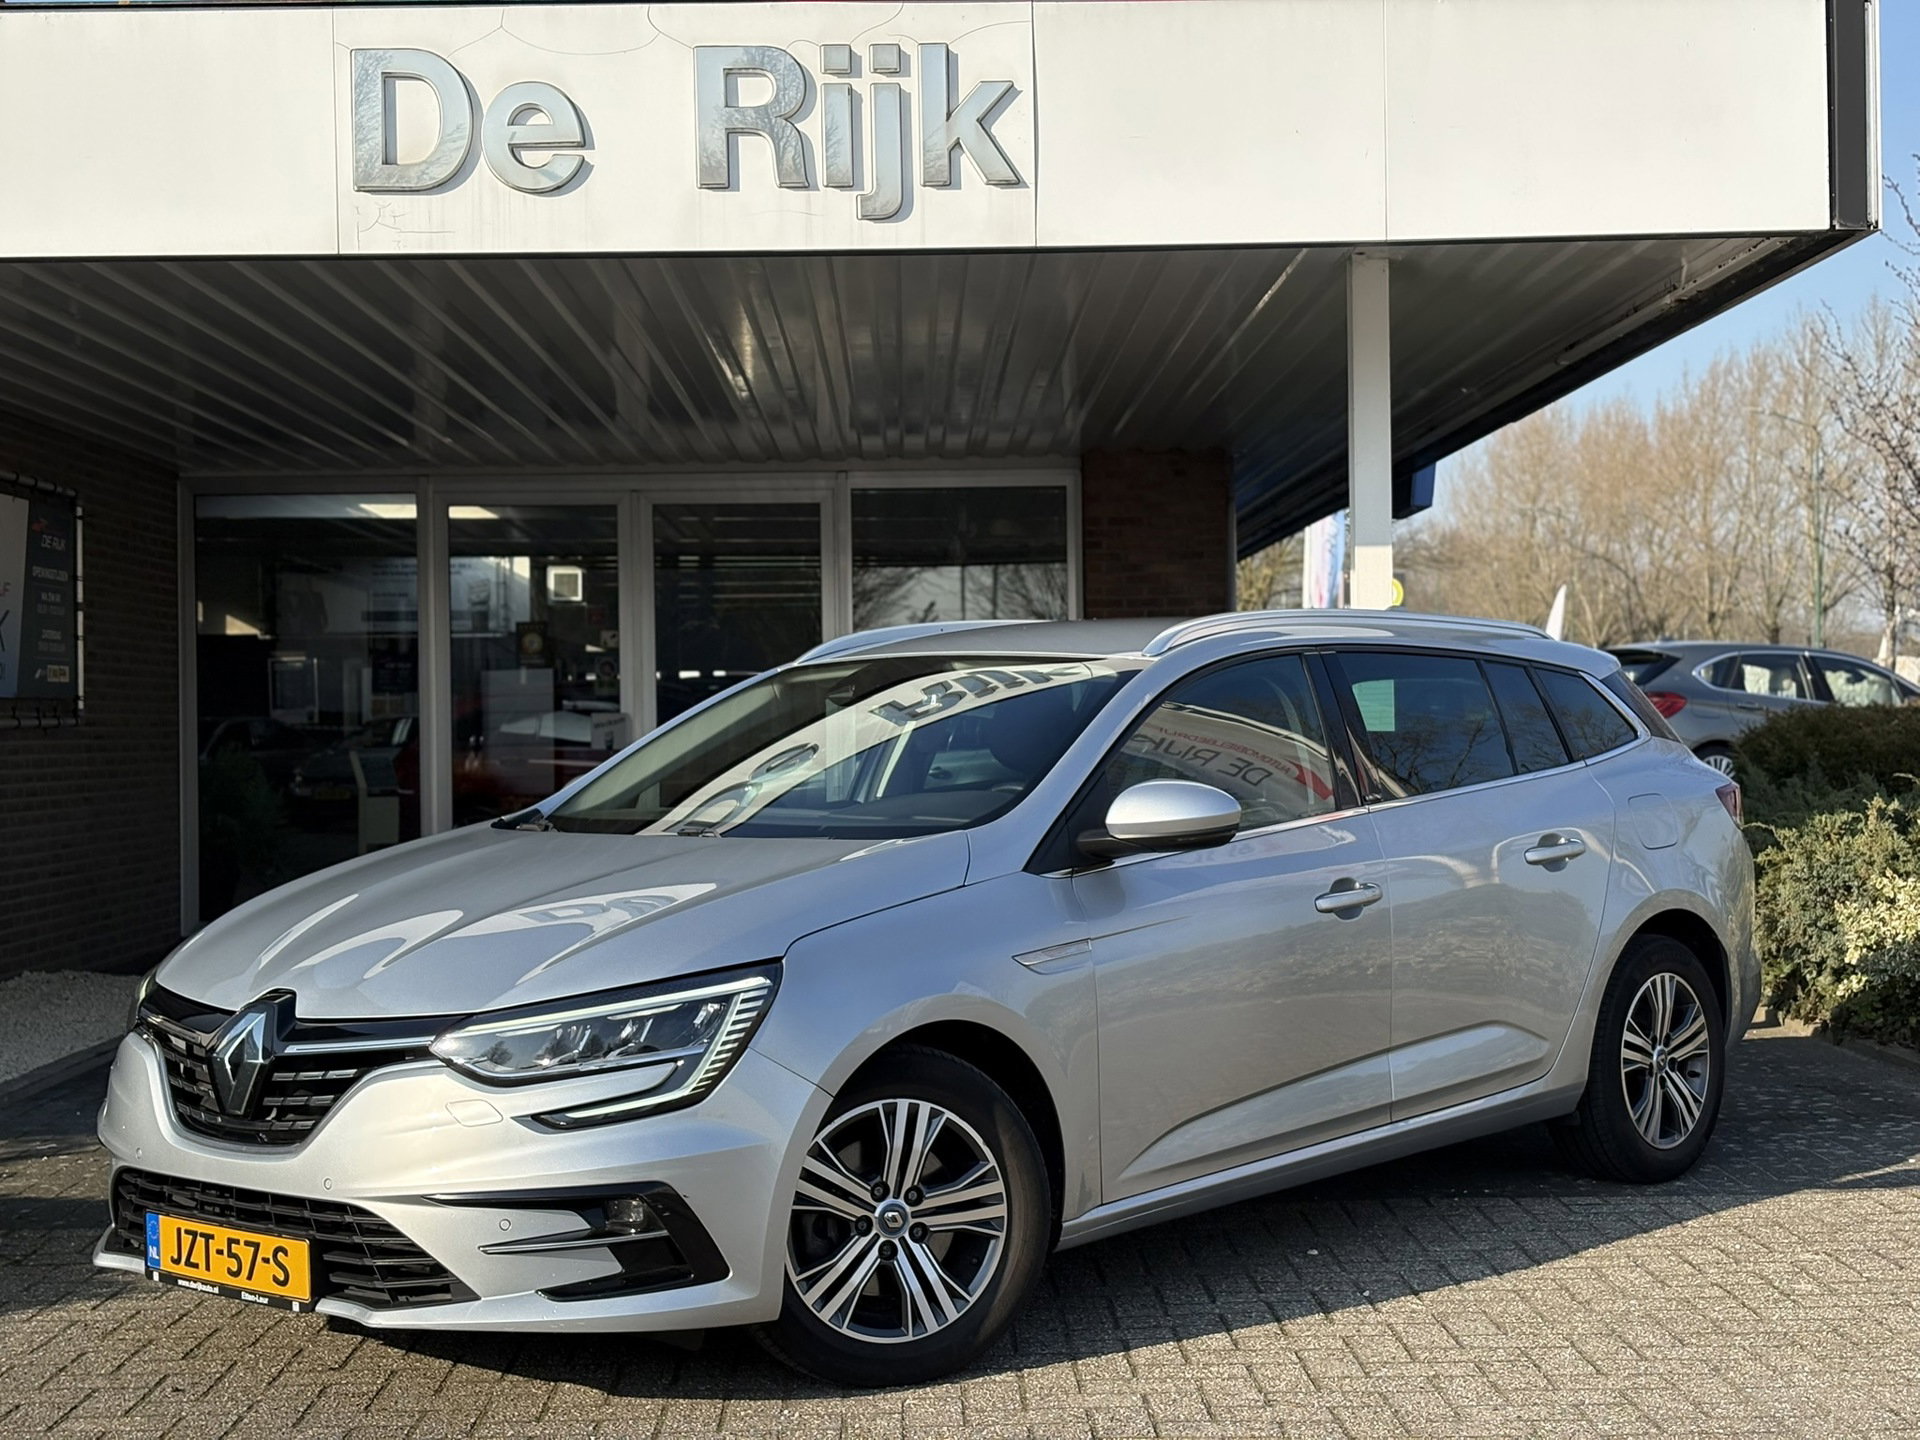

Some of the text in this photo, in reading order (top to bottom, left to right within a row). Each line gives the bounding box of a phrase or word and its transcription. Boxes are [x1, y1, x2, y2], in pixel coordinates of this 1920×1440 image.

[350, 42, 1023, 220] De Rijk
[148, 1245, 160, 1260] NL
[170, 1226, 290, 1288] JZT-57-S
